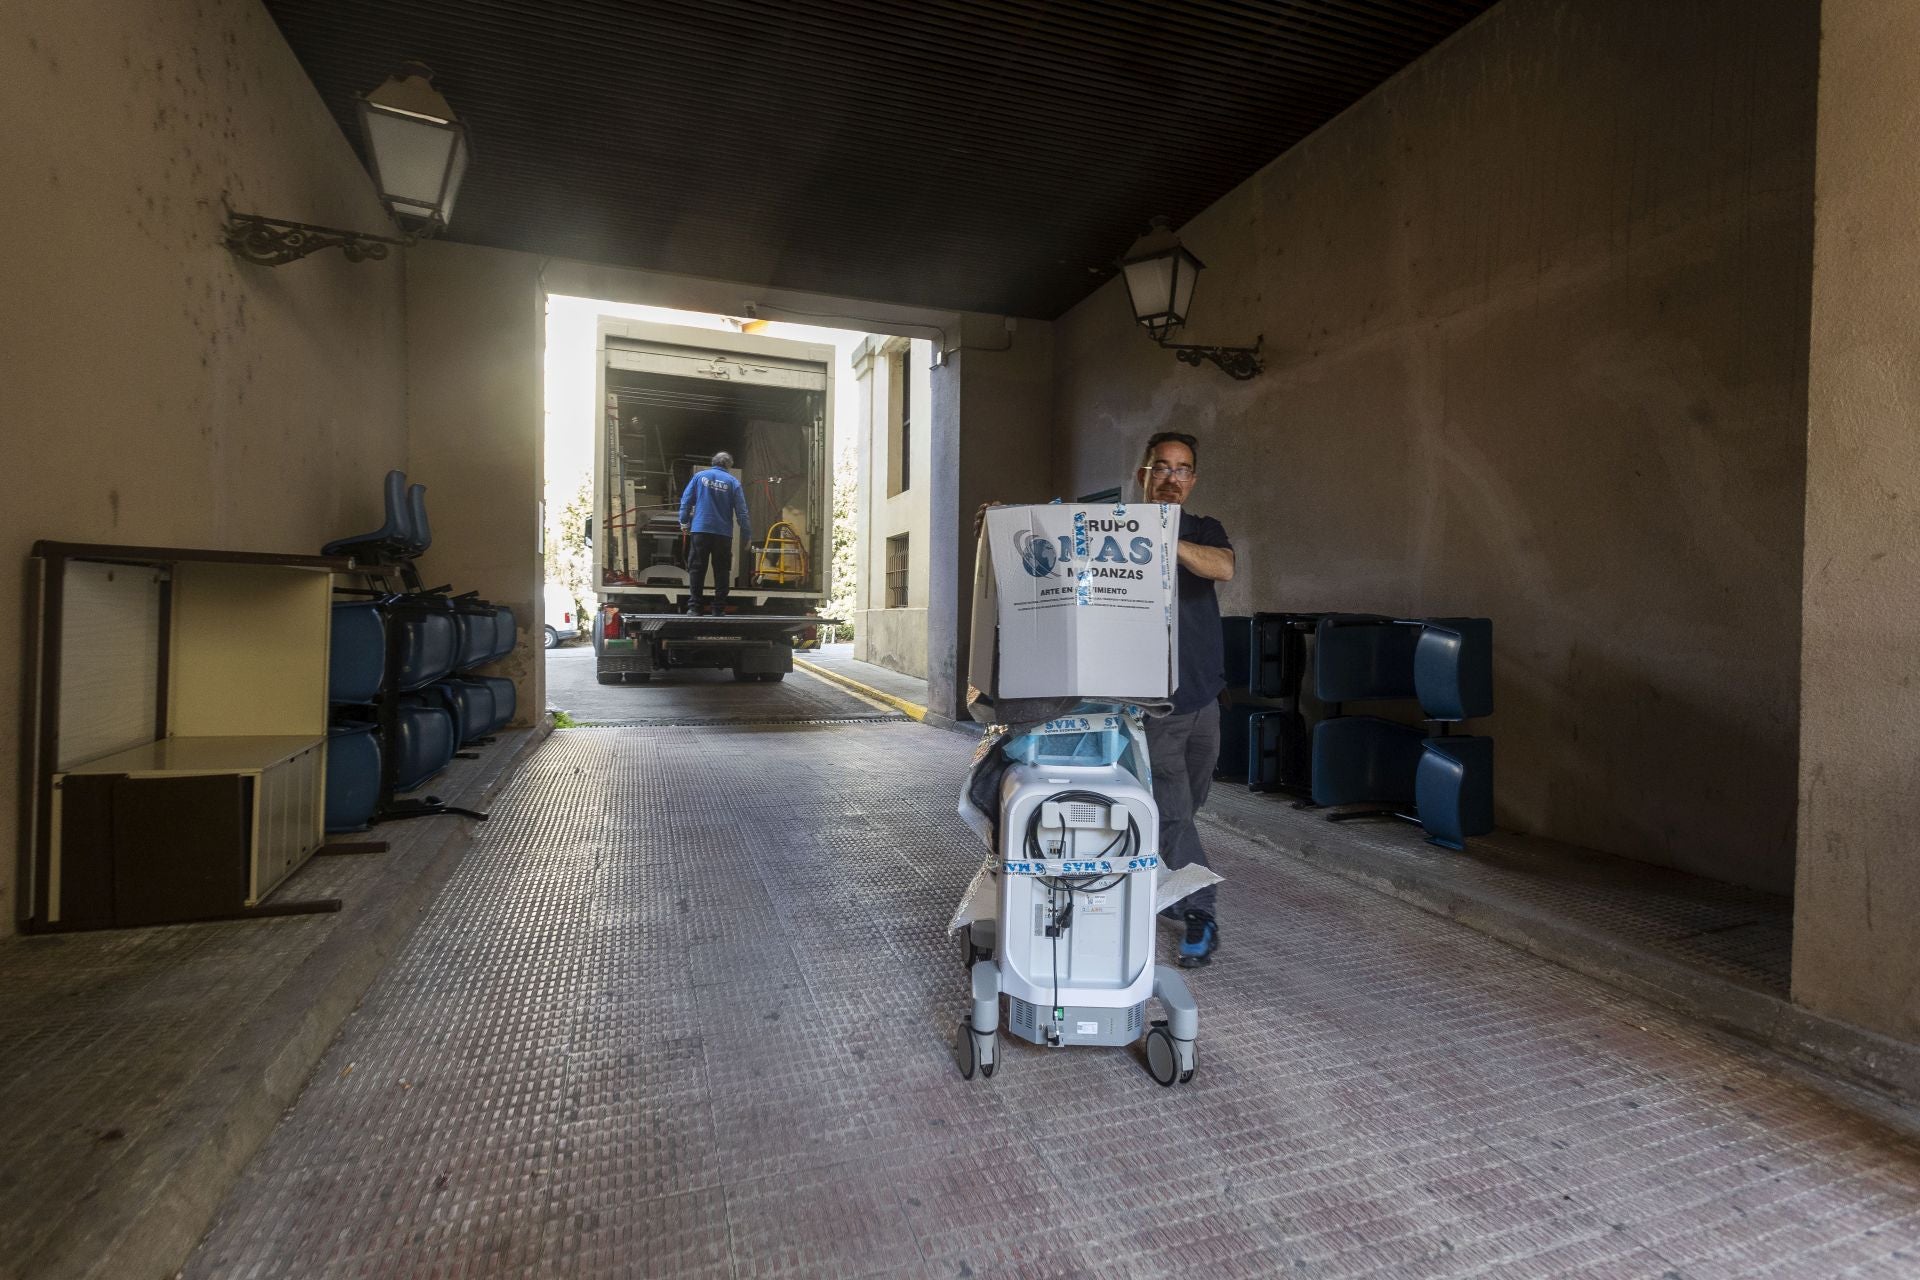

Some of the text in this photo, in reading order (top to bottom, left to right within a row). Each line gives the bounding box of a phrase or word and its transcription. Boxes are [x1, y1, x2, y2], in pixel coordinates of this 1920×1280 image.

[1089, 519, 1140, 533] RUPO
[1076, 525, 1086, 556] MAS
[1067, 567, 1144, 580] MDANZAS
[1040, 586, 1128, 596] ARTE EN IMIENTO
[1045, 719, 1076, 730] MAS
[1062, 862, 1097, 872] MAS
